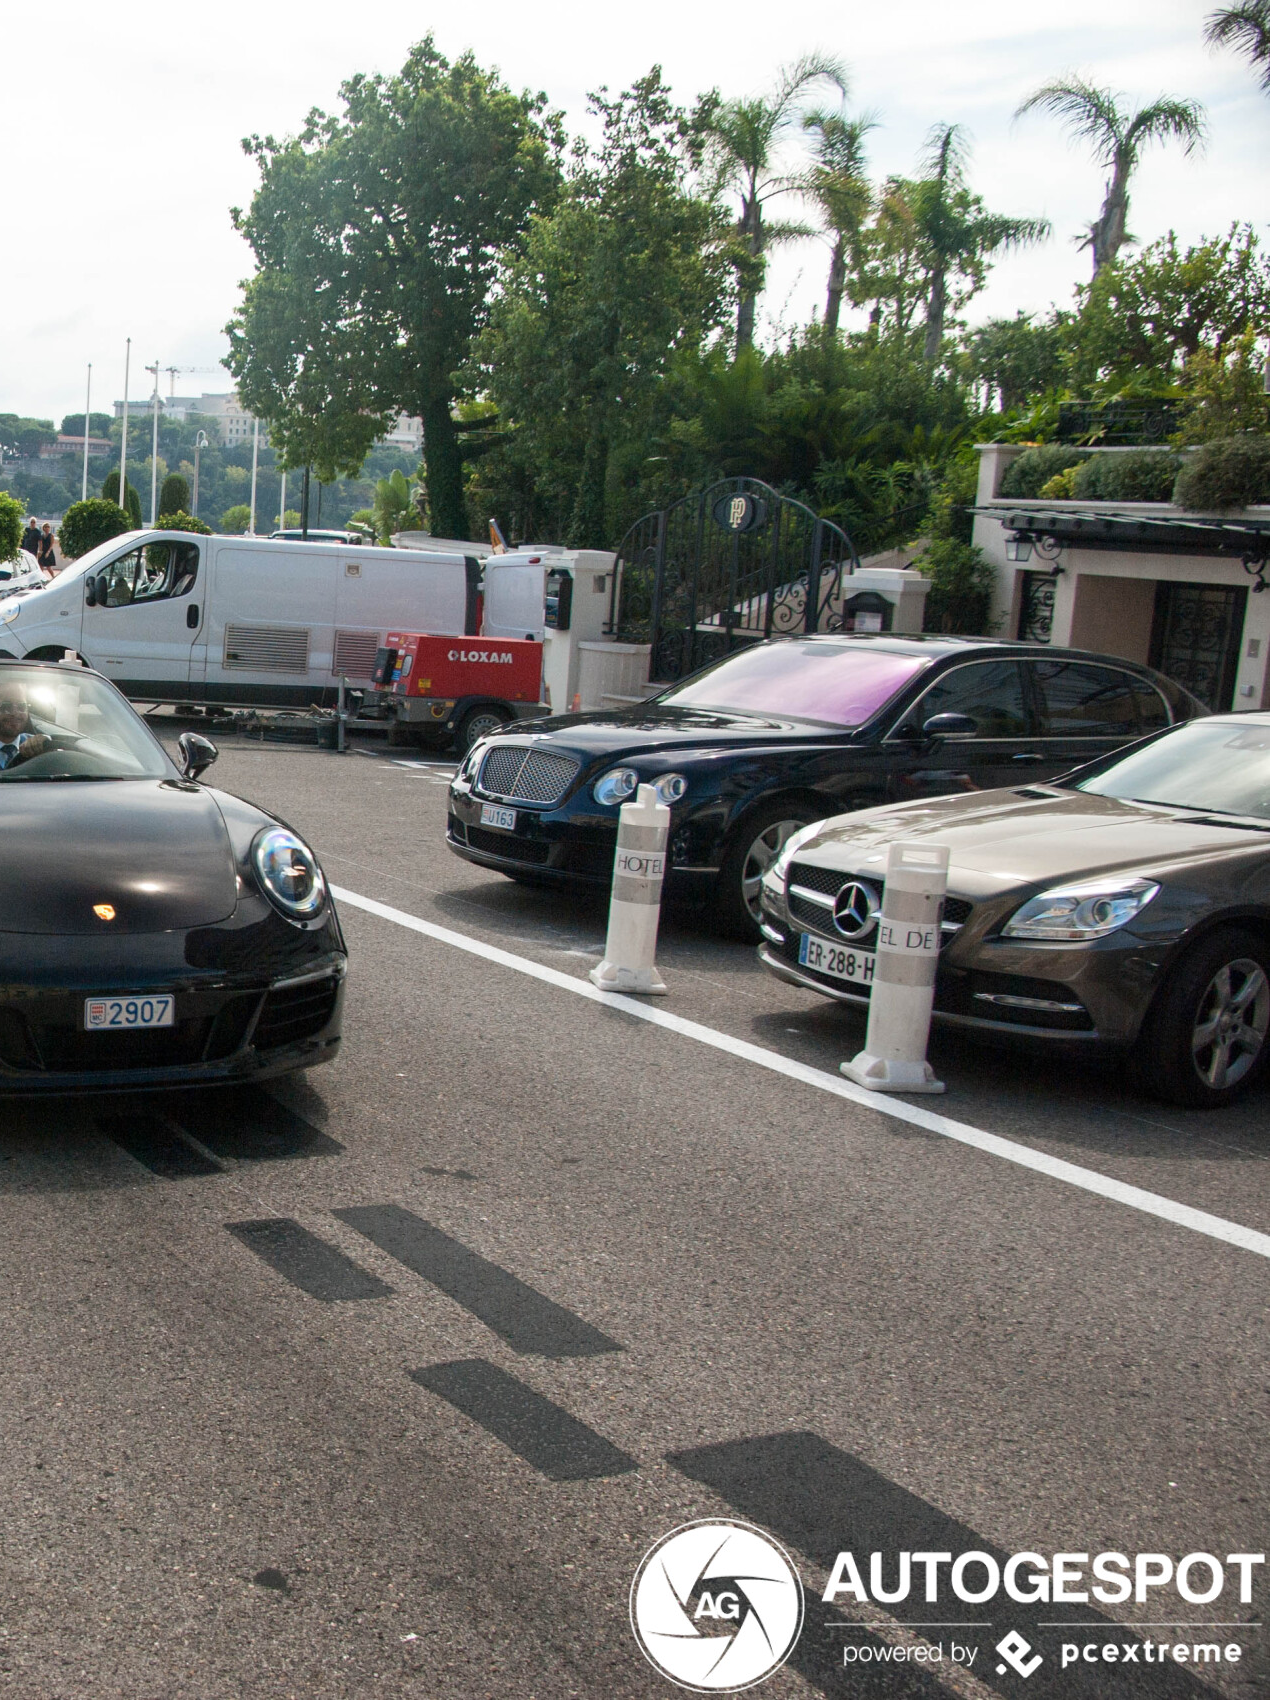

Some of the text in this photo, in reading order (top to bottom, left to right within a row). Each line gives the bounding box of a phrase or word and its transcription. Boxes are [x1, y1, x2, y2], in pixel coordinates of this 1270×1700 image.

[460, 650, 513, 664] LOXAM
[489, 809, 514, 827] U163
[617, 854, 664, 874] HOTEL
[906, 930, 934, 950] DE
[808, 940, 876, 982] ER-288-H
[109, 1000, 170, 1025] 2907
